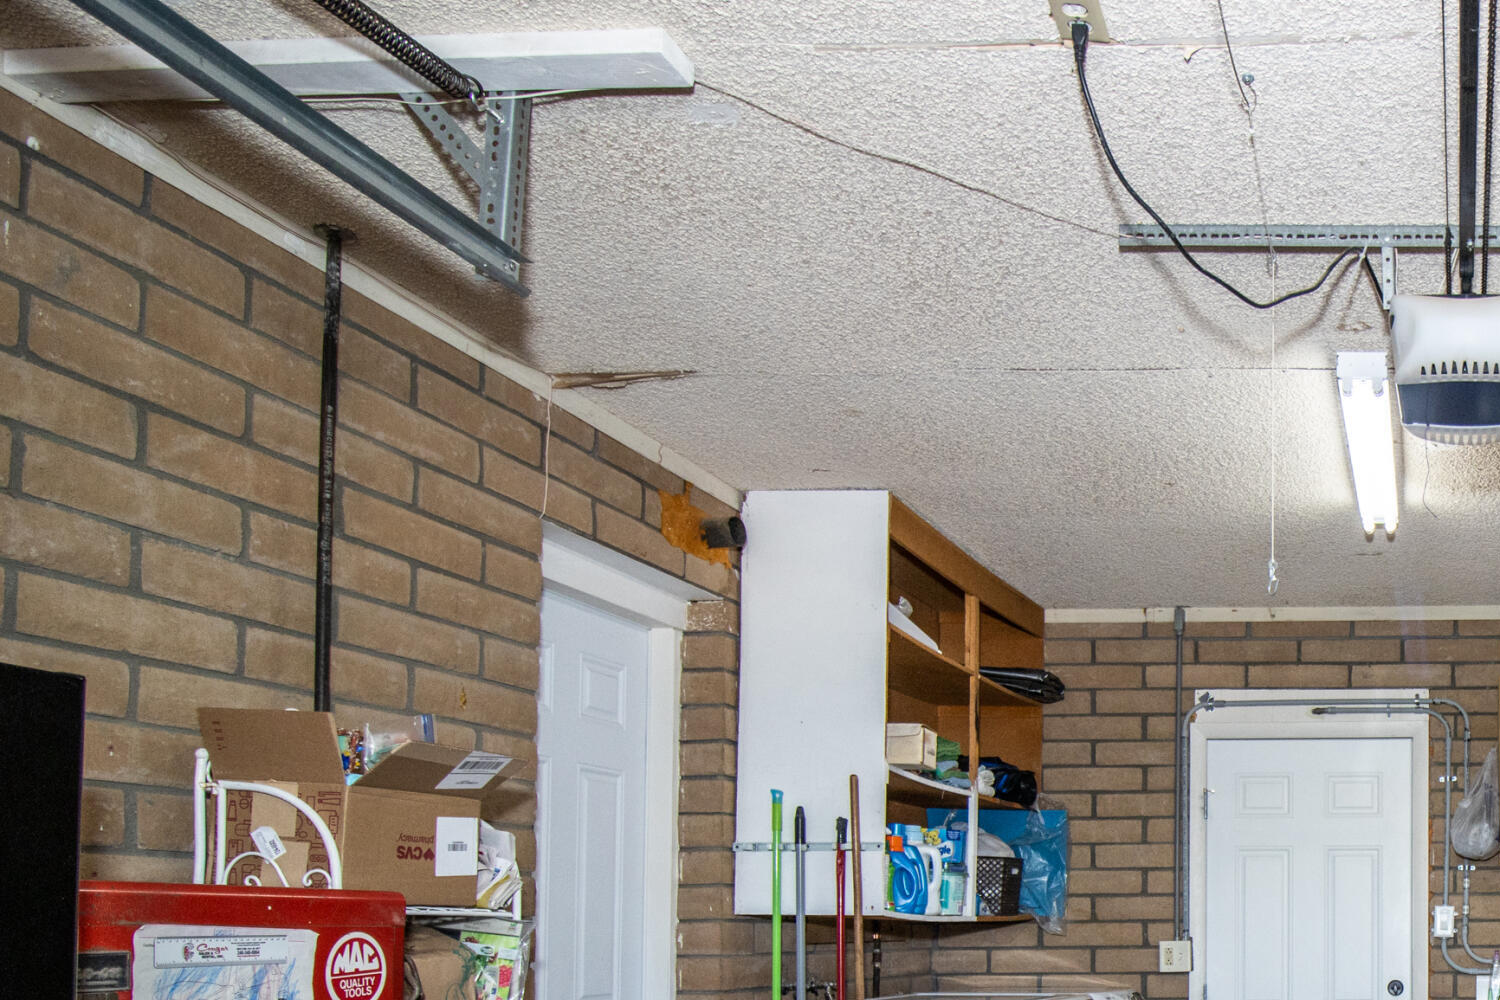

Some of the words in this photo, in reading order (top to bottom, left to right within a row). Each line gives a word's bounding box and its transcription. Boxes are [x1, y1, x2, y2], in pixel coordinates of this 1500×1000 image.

[396, 845, 423, 860] CVS
[333, 941, 380, 974] MAC
[339, 976, 376, 990] QUALITY
[344, 986, 372, 998] TOOLS
